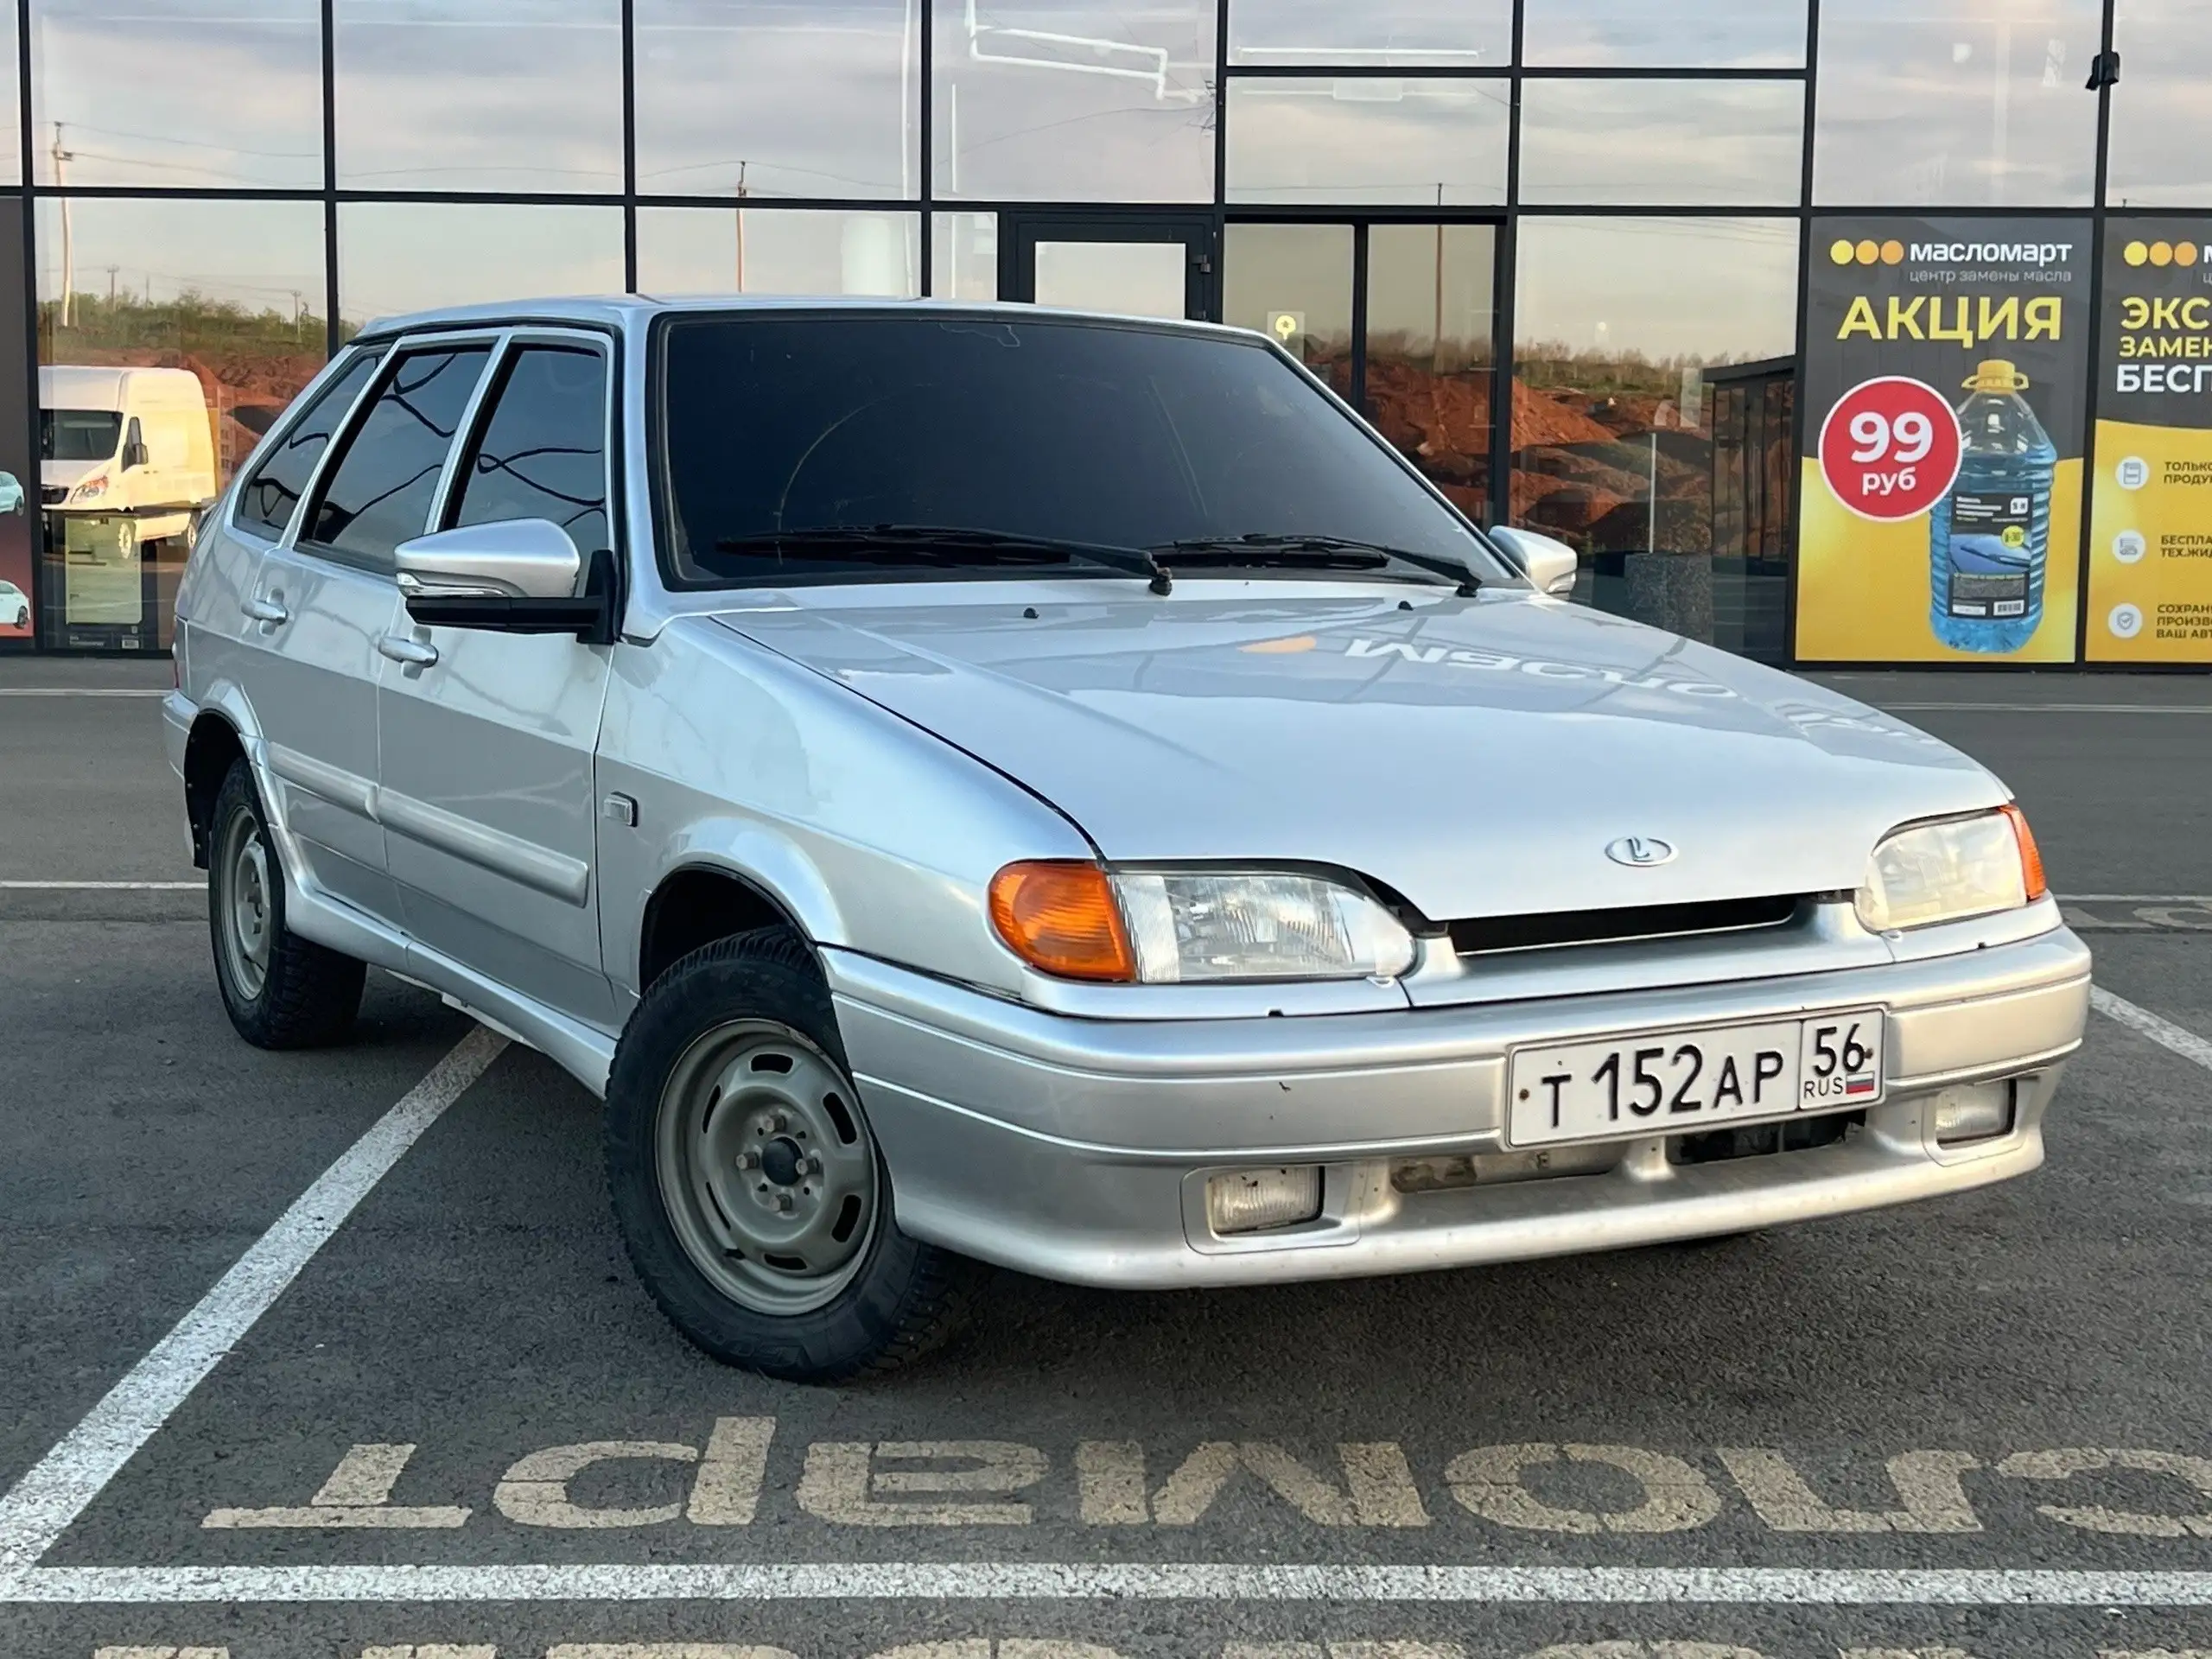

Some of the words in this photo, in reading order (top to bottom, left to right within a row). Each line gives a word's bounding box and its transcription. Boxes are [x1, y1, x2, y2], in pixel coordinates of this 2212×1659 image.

[1910, 243, 2073, 267] масломарт
[1910, 270, 1955, 284] центр
[1959, 270, 2019, 283] замены
[2024, 270, 2072, 283] масла
[1836, 296, 2063, 349] АКЦИЯ
[2120, 296, 2212, 330] ЭКС
[1850, 411, 1934, 463] 99
[1862, 467, 1916, 496] руб
[2160, 547, 2212, 558] ТЕХ.ЖИ
[2157, 604, 2212, 614] СОХРАН
[2157, 616, 2212, 626] ПРОИЗВ
[2157, 629, 2187, 639] ВАШ
[1814, 1023, 1866, 1077] 56
[1804, 1077, 1844, 1100] RUS
